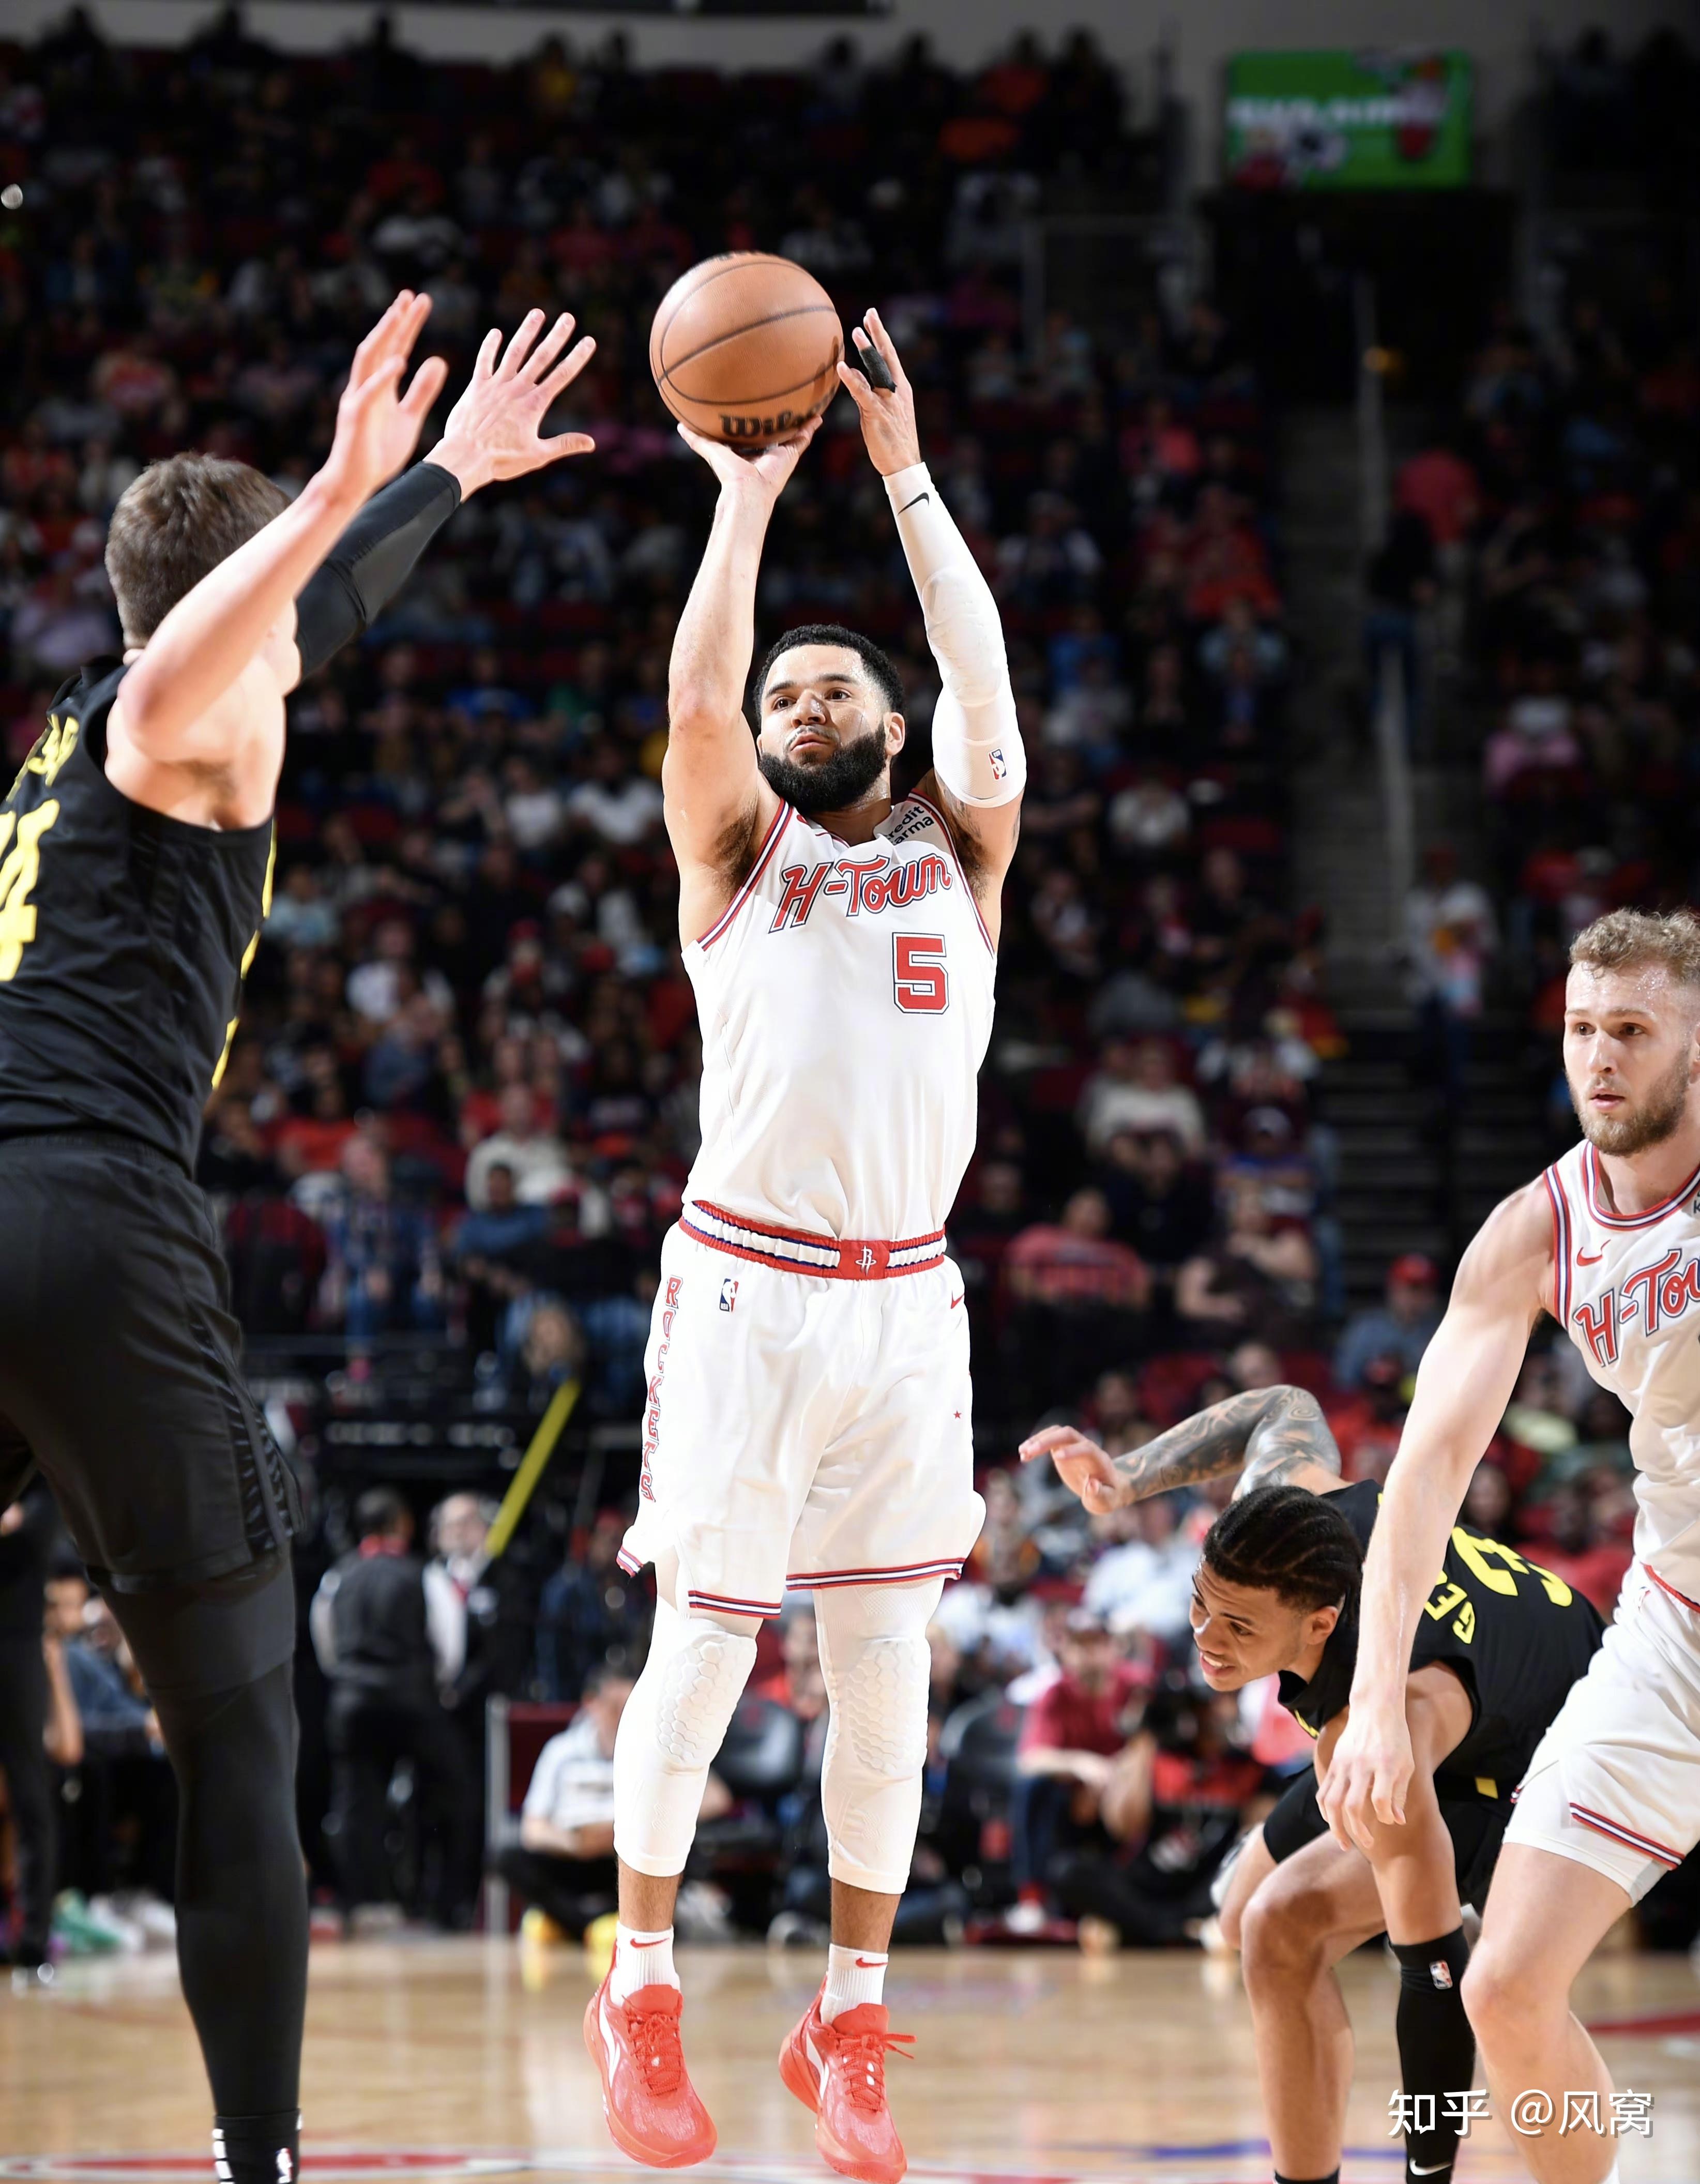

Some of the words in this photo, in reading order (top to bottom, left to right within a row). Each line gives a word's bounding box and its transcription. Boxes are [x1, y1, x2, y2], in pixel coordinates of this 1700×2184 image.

[884, 806, 924, 840] redit
[890, 816, 934, 845] arma
[0, 798, 60, 981] 4
[768, 854, 952, 934] H-Town
[892, 932, 949, 1014] 5
[639, 1275, 683, 1503] ROCKETS
